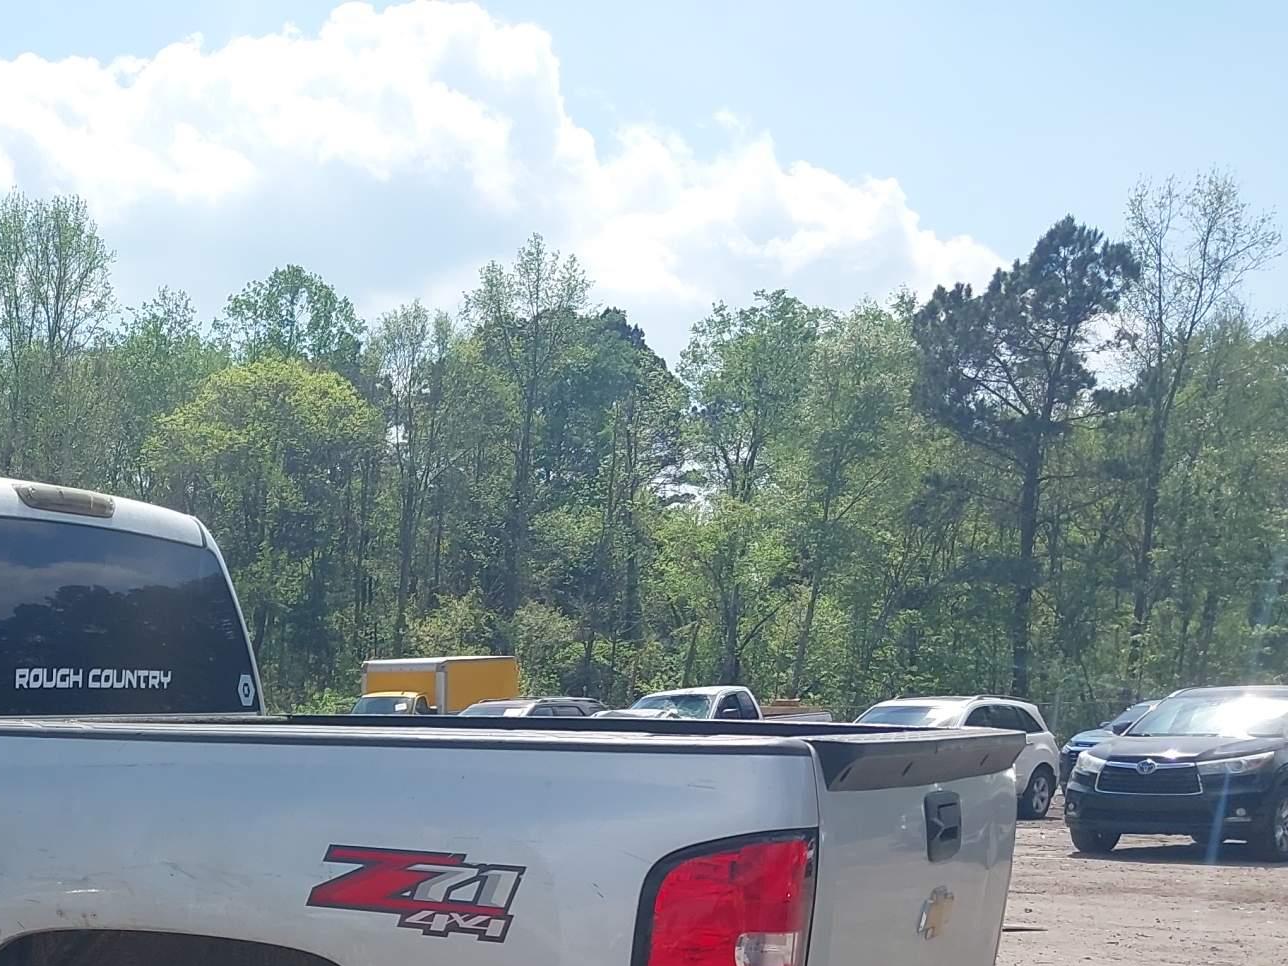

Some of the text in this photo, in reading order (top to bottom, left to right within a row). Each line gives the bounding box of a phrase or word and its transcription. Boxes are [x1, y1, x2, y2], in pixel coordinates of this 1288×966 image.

[15, 668, 172, 689] ROUGH COUNTRY
[305, 844, 527, 914] Z71
